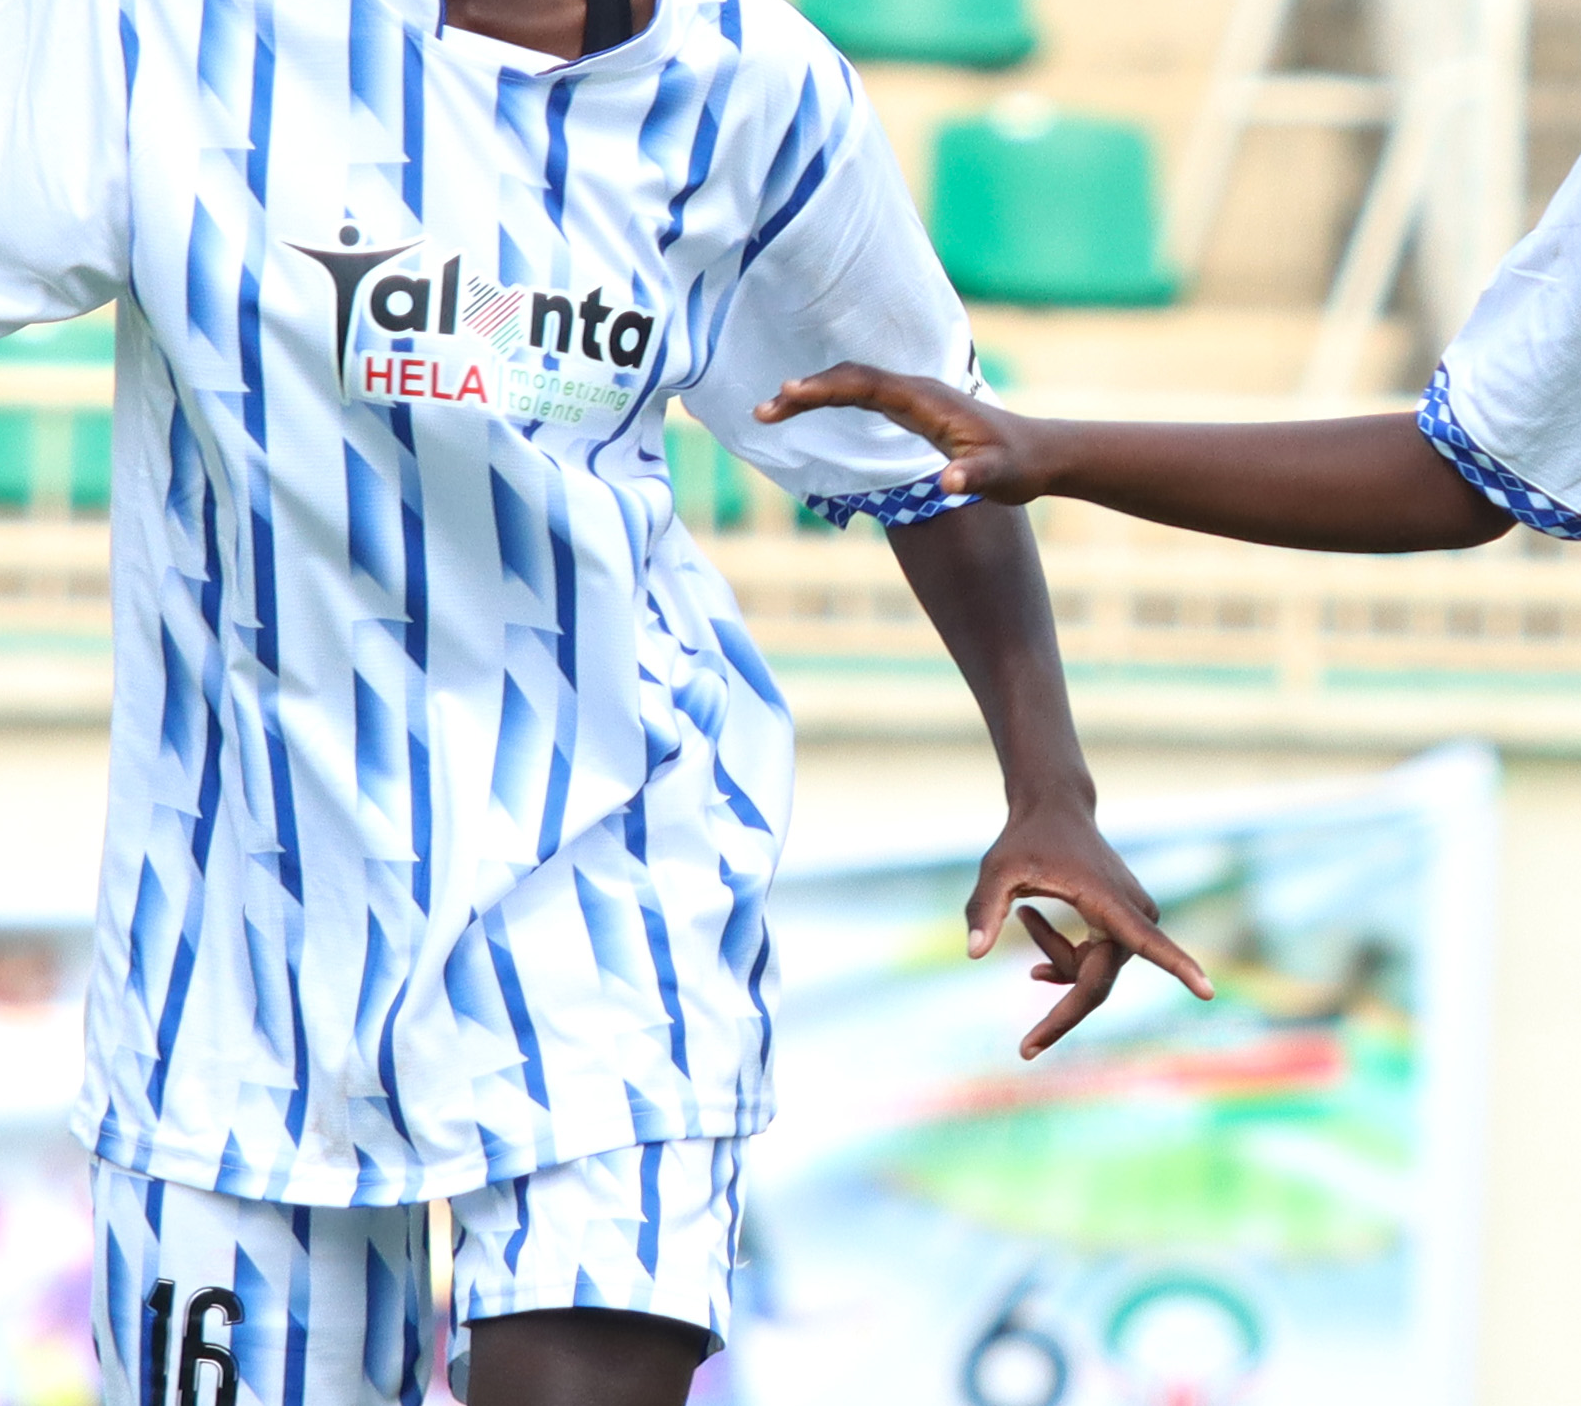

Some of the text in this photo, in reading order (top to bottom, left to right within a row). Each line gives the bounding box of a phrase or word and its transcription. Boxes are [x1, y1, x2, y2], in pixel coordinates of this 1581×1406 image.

[365, 356, 488, 404] HELA
[510, 366, 632, 413] monetizing
[509, 393, 585, 425] talents
